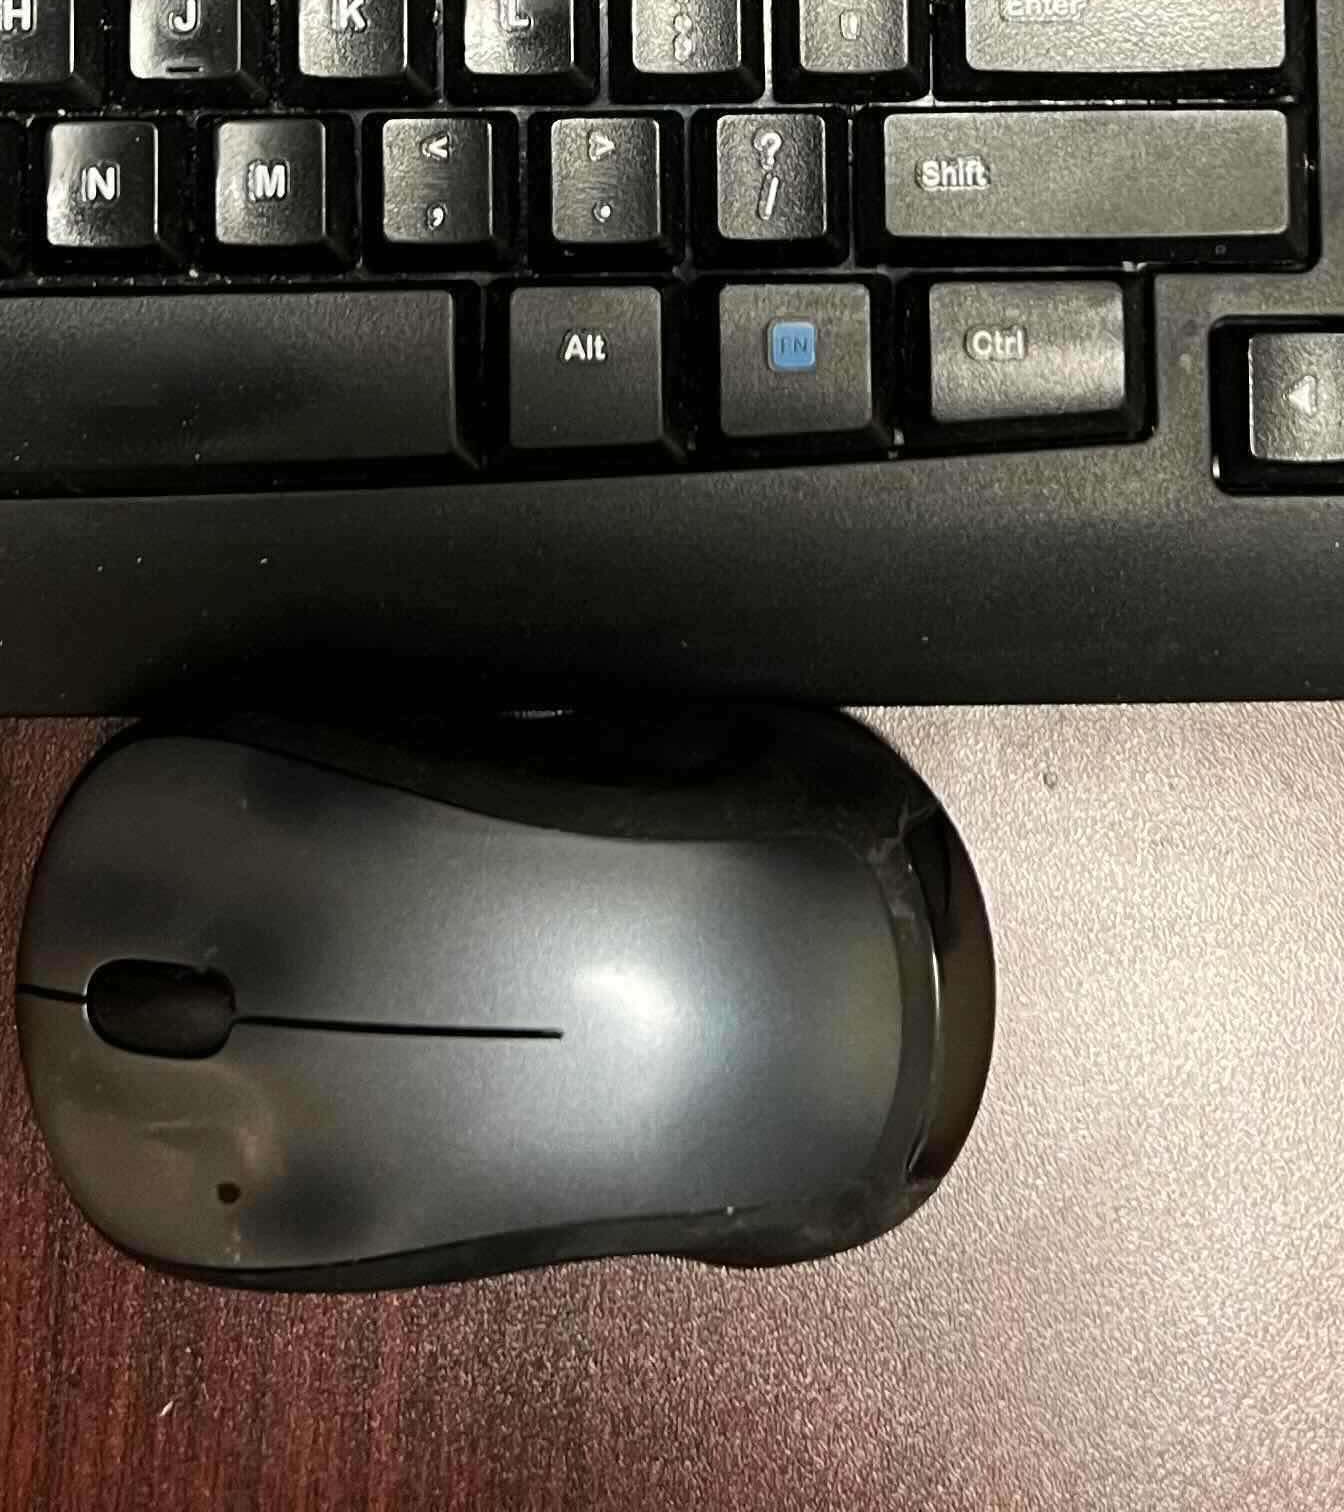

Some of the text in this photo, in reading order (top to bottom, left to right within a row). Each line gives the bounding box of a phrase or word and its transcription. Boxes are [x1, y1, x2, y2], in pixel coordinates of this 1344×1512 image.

[423, 135, 449, 158] <
[592, 135, 615, 159] >
[755, 133, 782, 168] ?
[85, 168, 117, 200] N
[253, 166, 285, 198] M
[921, 157, 988, 188] Shift
[763, 175, 778, 218] /
[564, 335, 605, 360] Alt
[971, 328, 1024, 356] Ctrl
